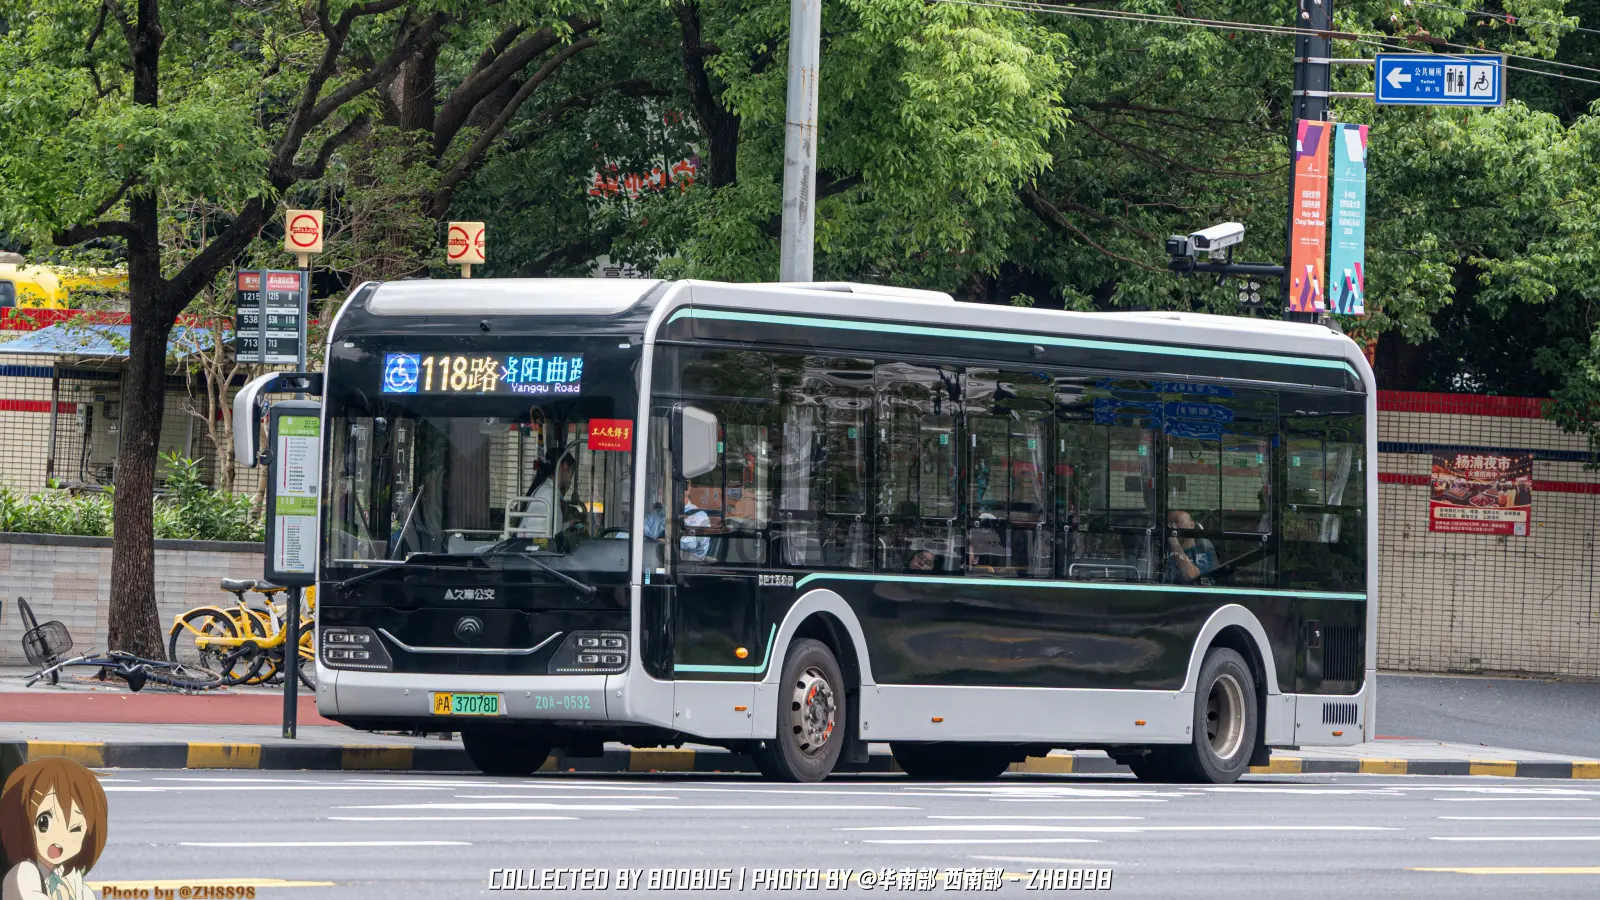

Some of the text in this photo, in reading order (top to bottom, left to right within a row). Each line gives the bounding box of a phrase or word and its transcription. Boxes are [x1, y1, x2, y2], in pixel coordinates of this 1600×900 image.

[1414, 67, 1442, 76] 公共厕所
[268, 316, 278, 324] 538
[286, 316, 295, 324] 118
[422, 356, 500, 392] 118路
[511, 383, 580, 393] Yangqu Road
[592, 426, 629, 440] 工人先锋号
[1455, 454, 1511, 470] 杨浦夜市
[436, 696, 497, 712] 沪A 37078D
